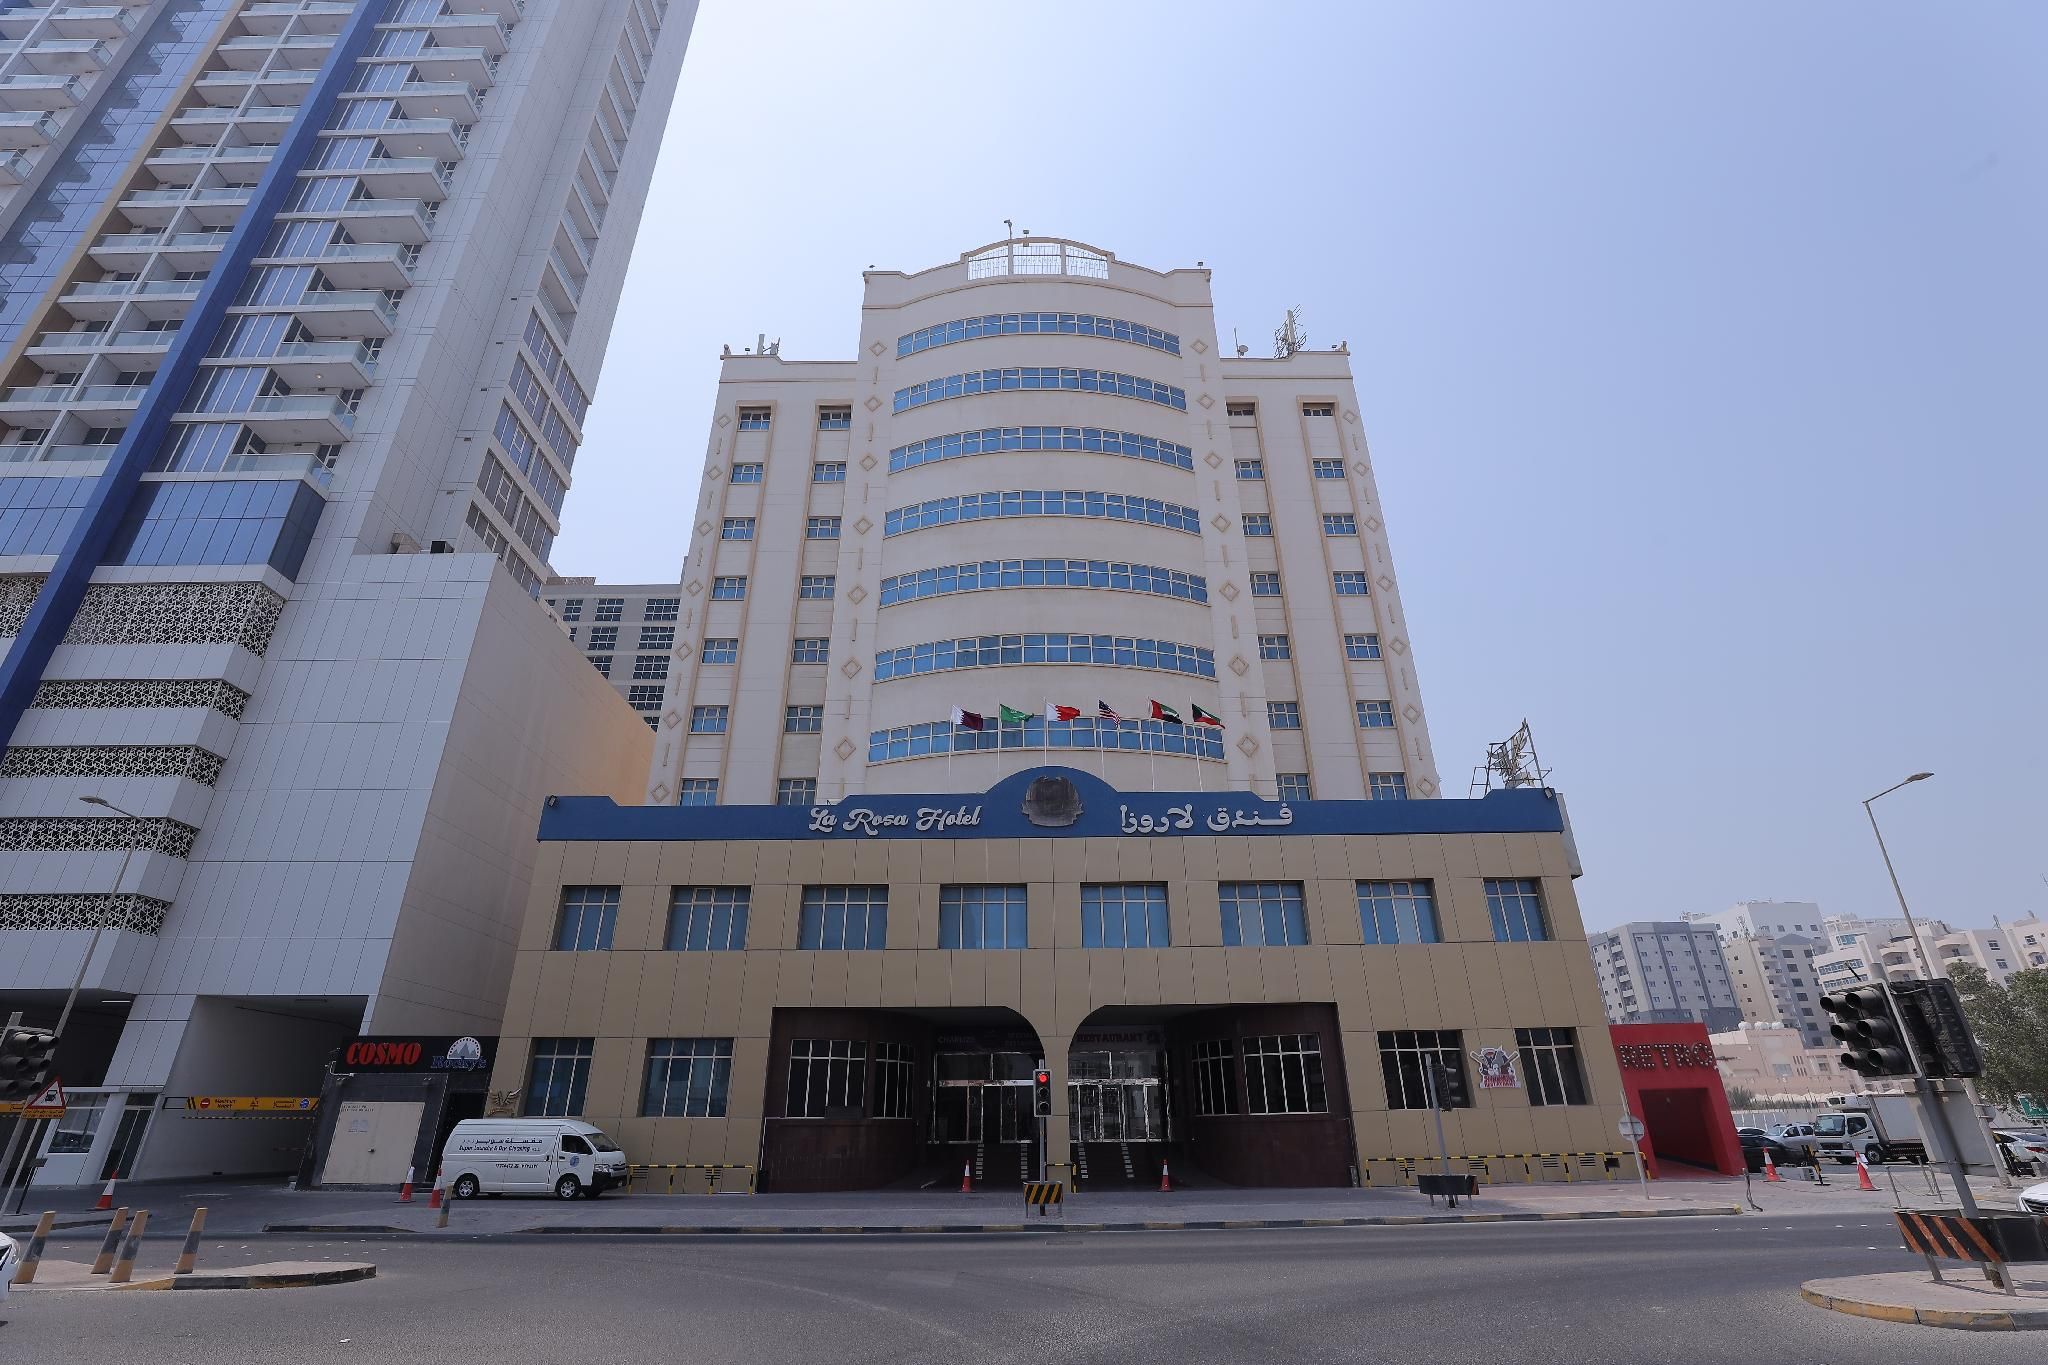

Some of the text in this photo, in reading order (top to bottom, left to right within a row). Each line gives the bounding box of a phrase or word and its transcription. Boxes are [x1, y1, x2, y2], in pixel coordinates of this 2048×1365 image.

[808, 805, 983, 836] La Rosa Hotel
[1119, 802, 1293, 834] فندق لاروزا
[345, 1042, 423, 1065] COSMO
[1617, 1043, 1713, 1069] RETRO
